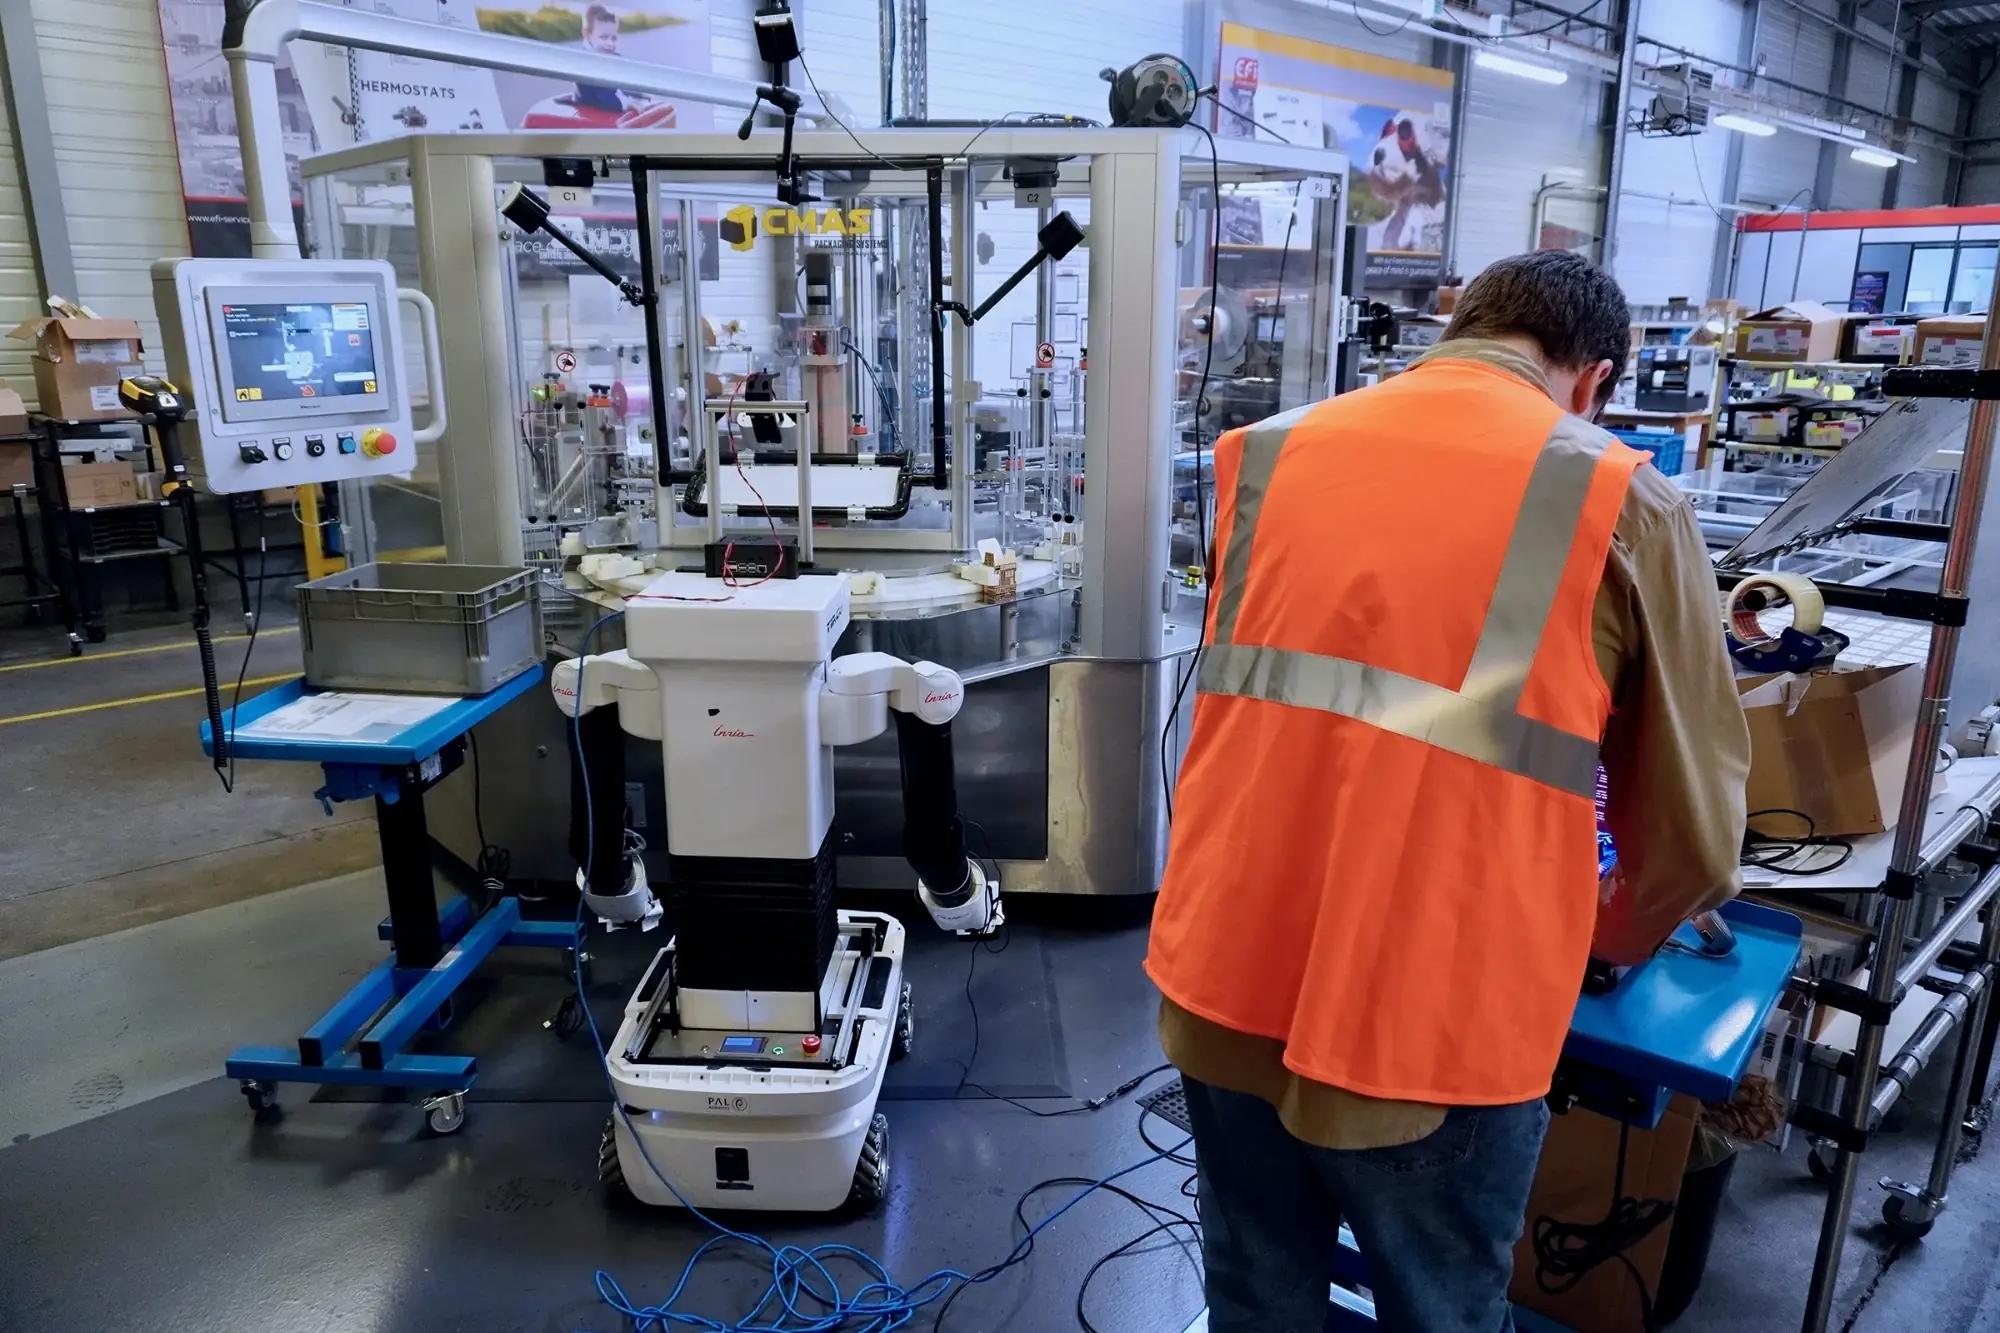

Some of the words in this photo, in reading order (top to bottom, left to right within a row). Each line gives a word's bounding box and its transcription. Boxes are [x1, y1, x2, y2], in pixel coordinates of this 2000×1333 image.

[360, 80, 456, 99] HERMOSTATS
[563, 191, 576, 201] C1
[1027, 193, 1040, 203] C2
[188, 214, 250, 224] www.efi-servic
[762, 208, 872, 235] CMAS
[708, 1097, 730, 1106] PAL
